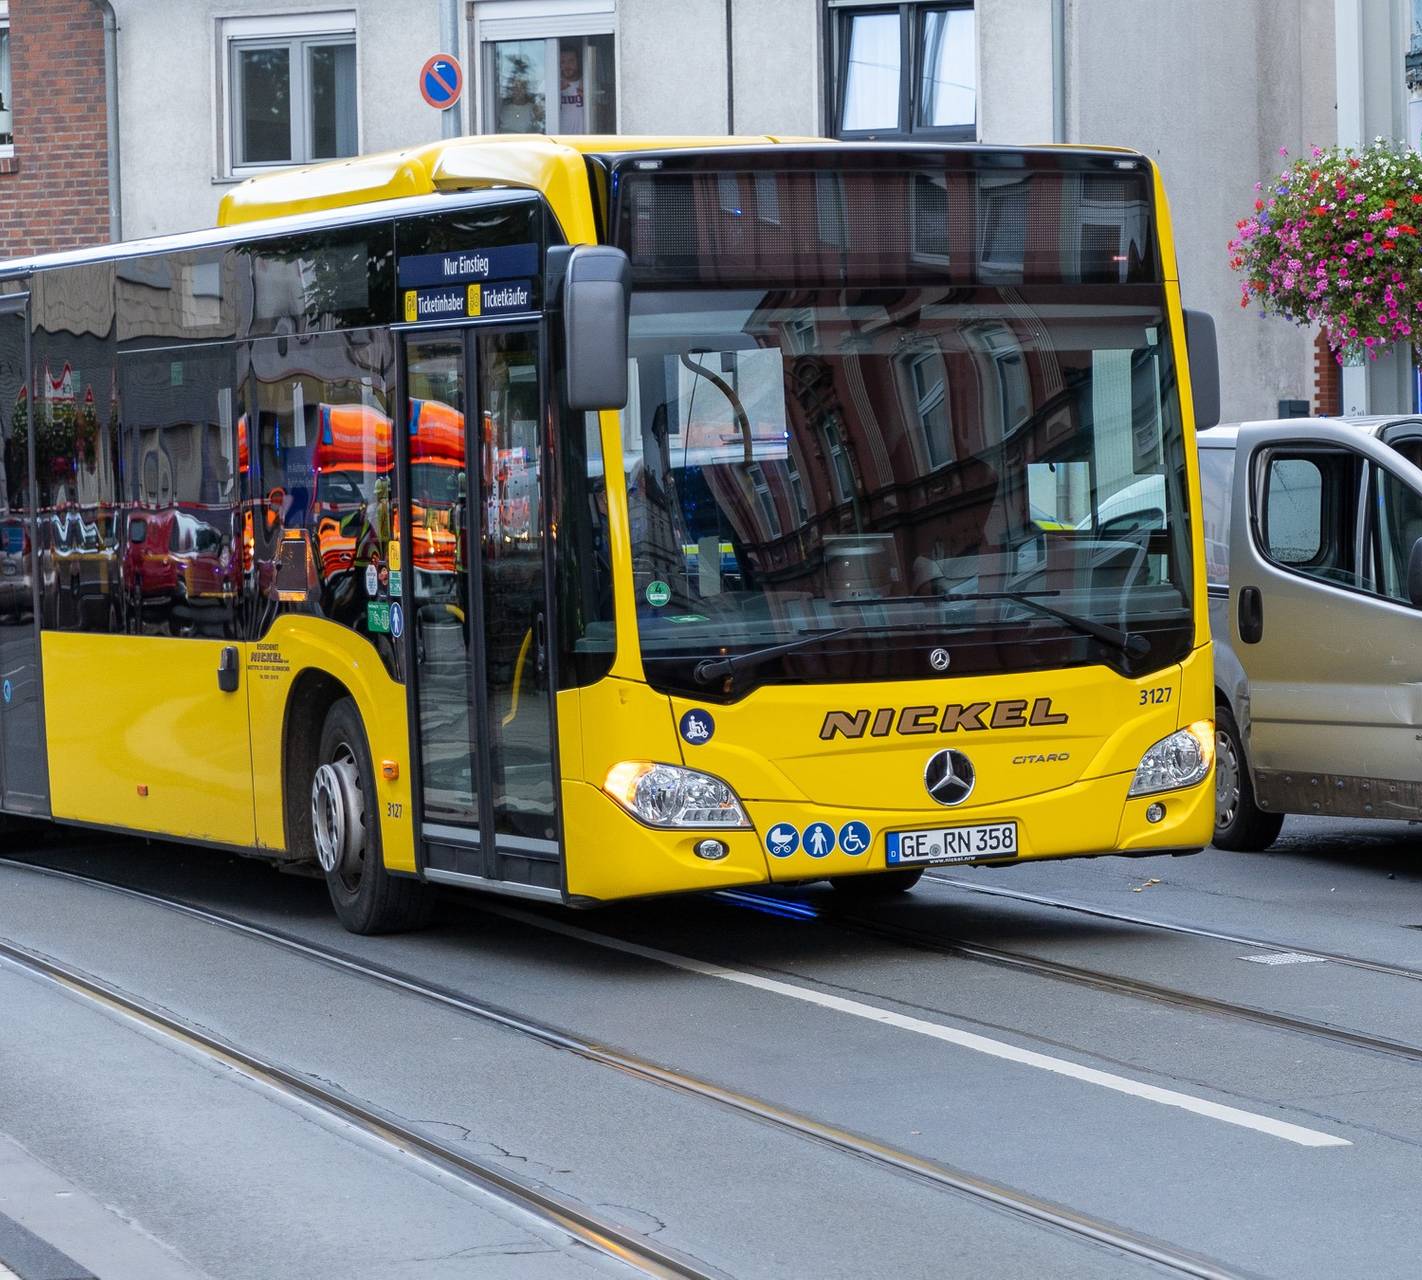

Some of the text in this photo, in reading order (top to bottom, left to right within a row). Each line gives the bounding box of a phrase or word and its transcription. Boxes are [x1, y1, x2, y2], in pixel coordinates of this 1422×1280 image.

[444, 255, 489, 276] Nur Einstieg
[418, 293, 464, 314] Ticketinhaber
[483, 286, 528, 308] Ticketkäufer
[655, 583, 662, 594] 4
[1139, 687, 1172, 705] 3127
[818, 697, 1070, 741] NICKEL
[1012, 752, 1070, 765] CITARO
[387, 802, 403, 818] 3127
[901, 827, 1014, 857] GE RN 358
